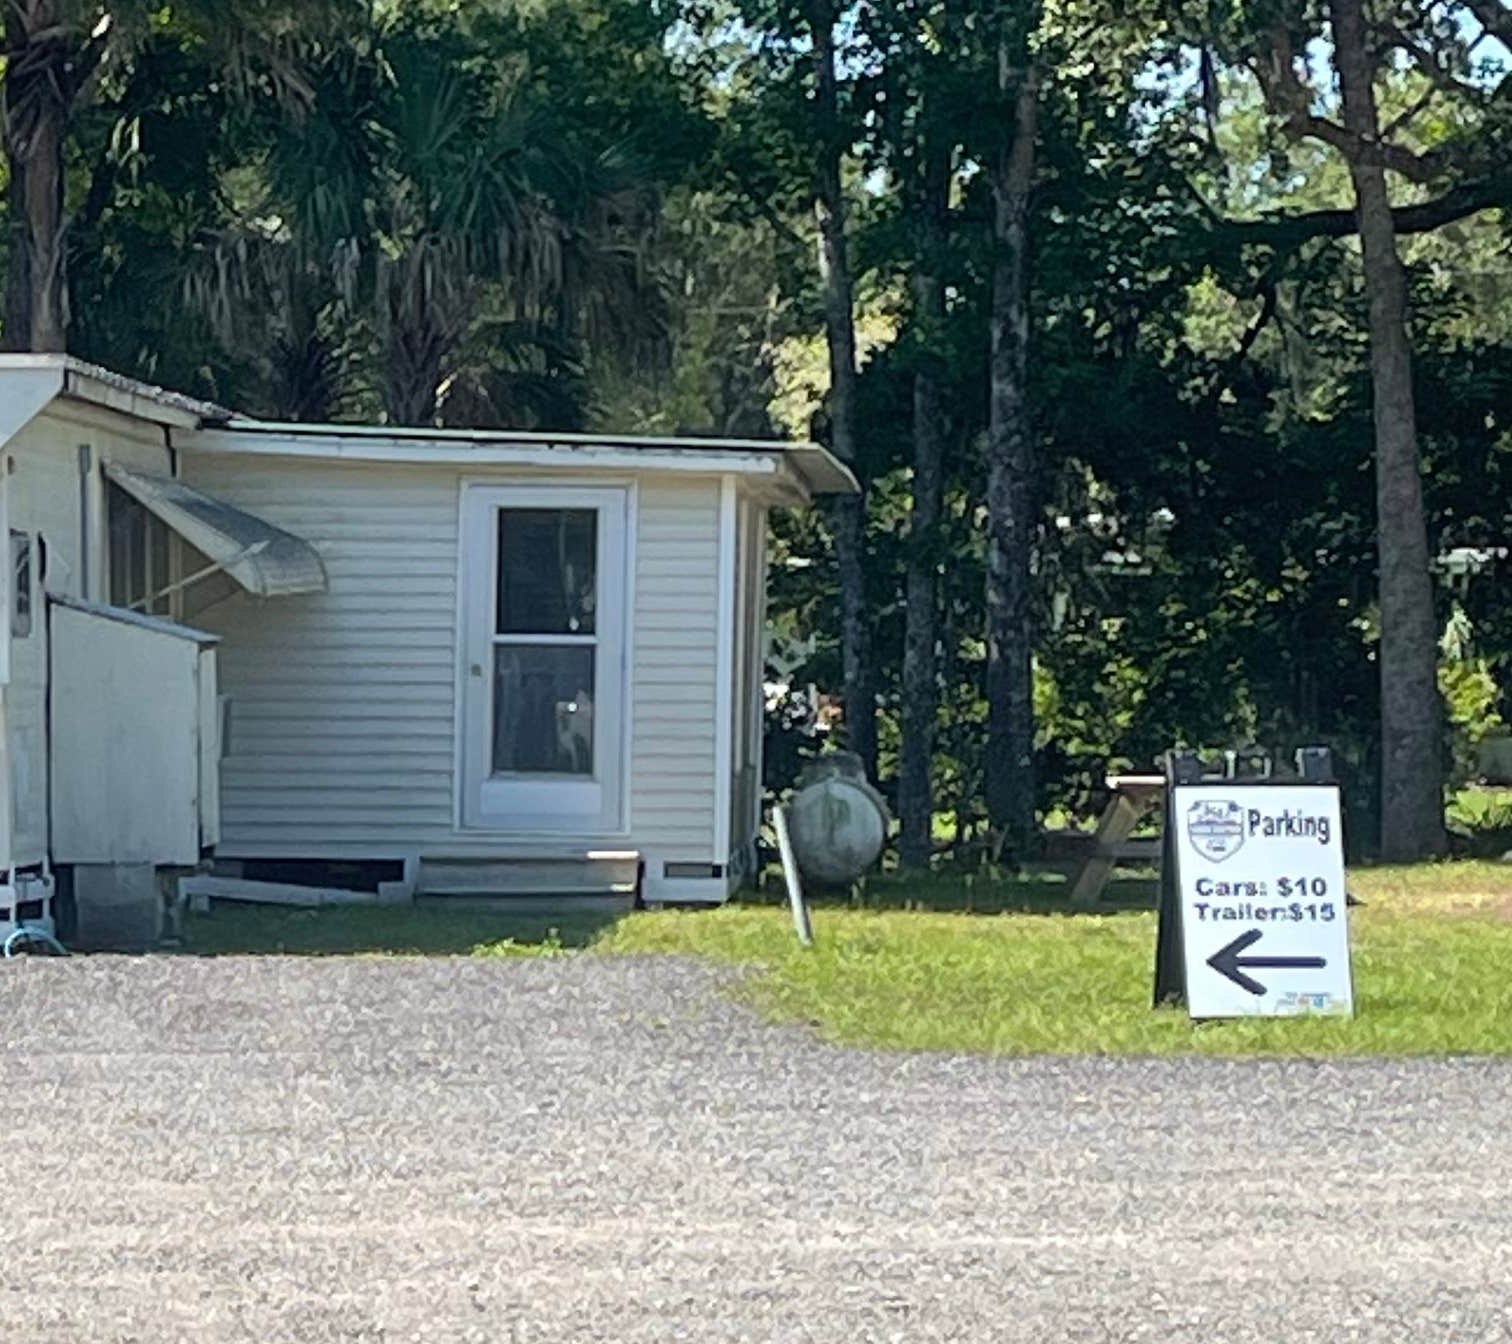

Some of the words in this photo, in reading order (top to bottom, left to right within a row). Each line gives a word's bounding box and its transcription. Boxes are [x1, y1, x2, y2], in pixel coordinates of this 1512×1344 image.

[1248, 808, 1331, 845] Parking
[1195, 877, 1267, 897] Cars:
[1277, 877, 1327, 897] $10
